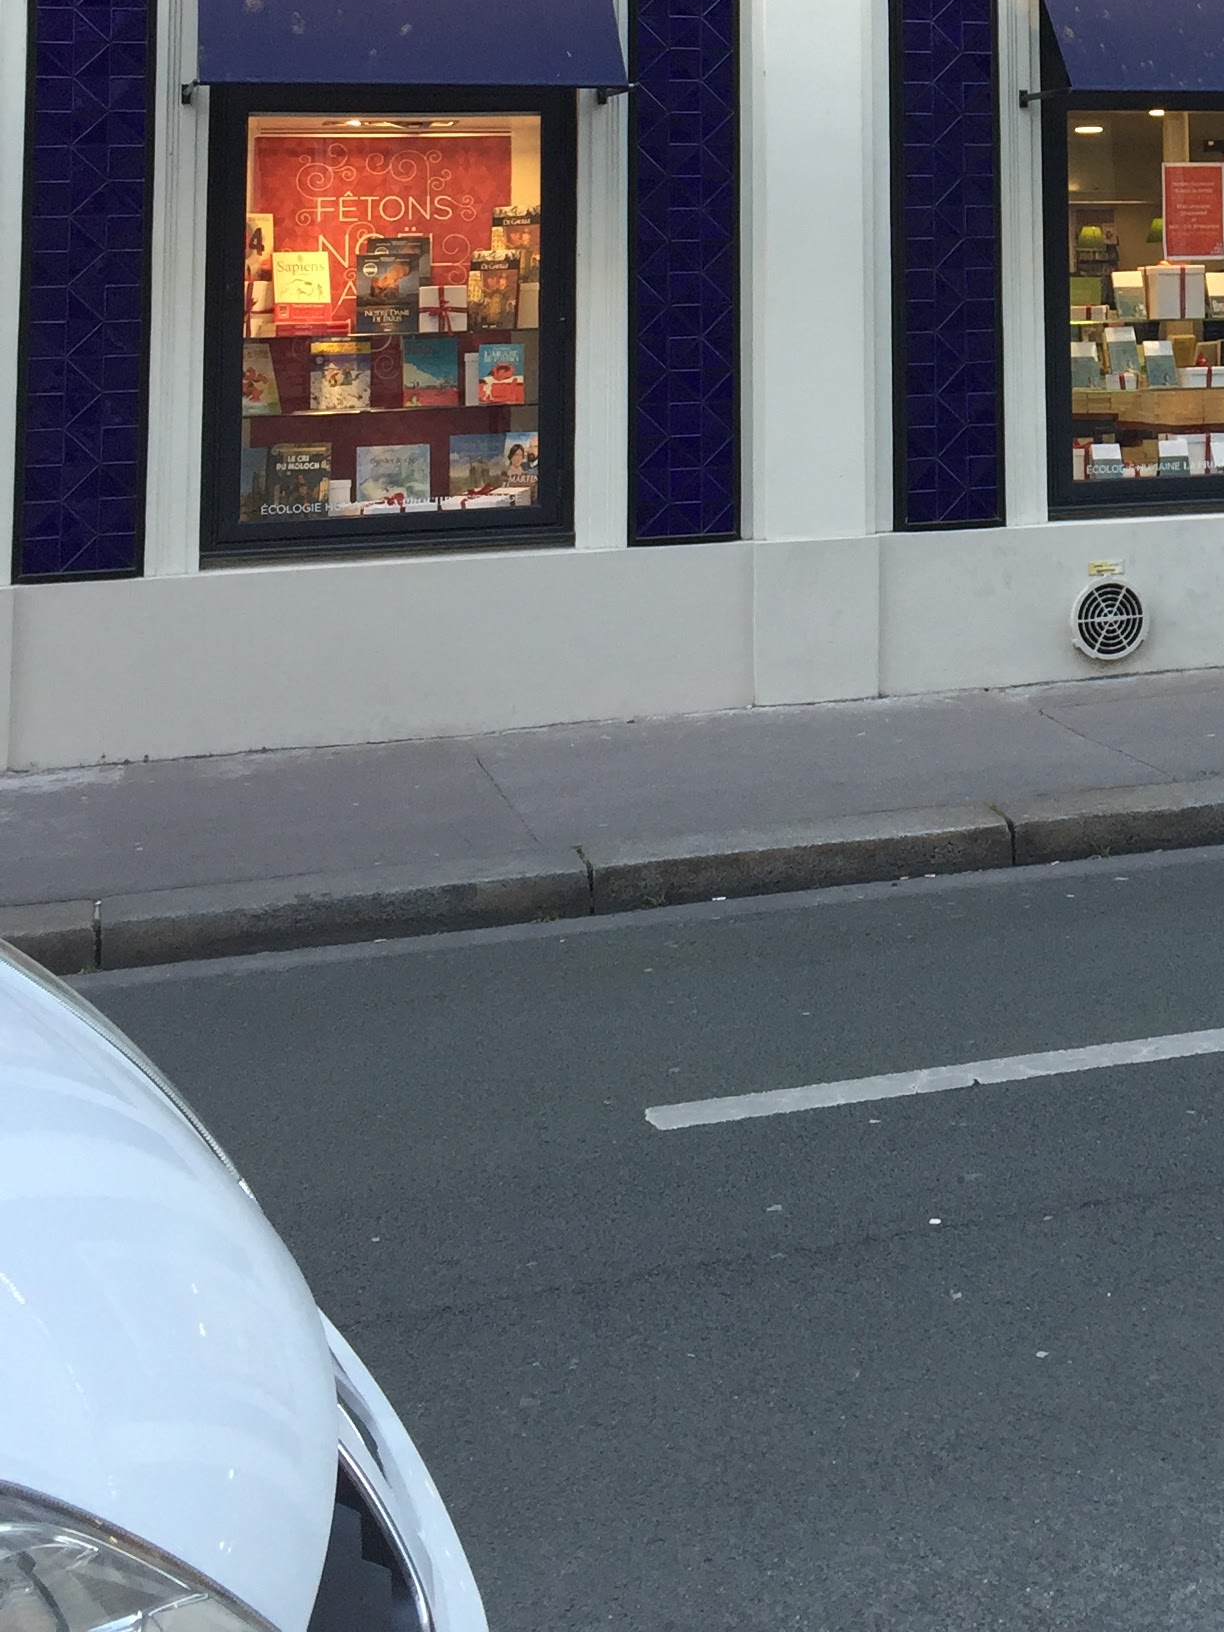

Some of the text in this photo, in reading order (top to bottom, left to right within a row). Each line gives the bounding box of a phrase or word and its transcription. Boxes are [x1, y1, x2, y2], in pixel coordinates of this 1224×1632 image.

[317, 191, 453, 222] FÊTONS
[276, 260, 326, 276] Sapiens
[260, 502, 322, 516] ÉCOLOGIE
